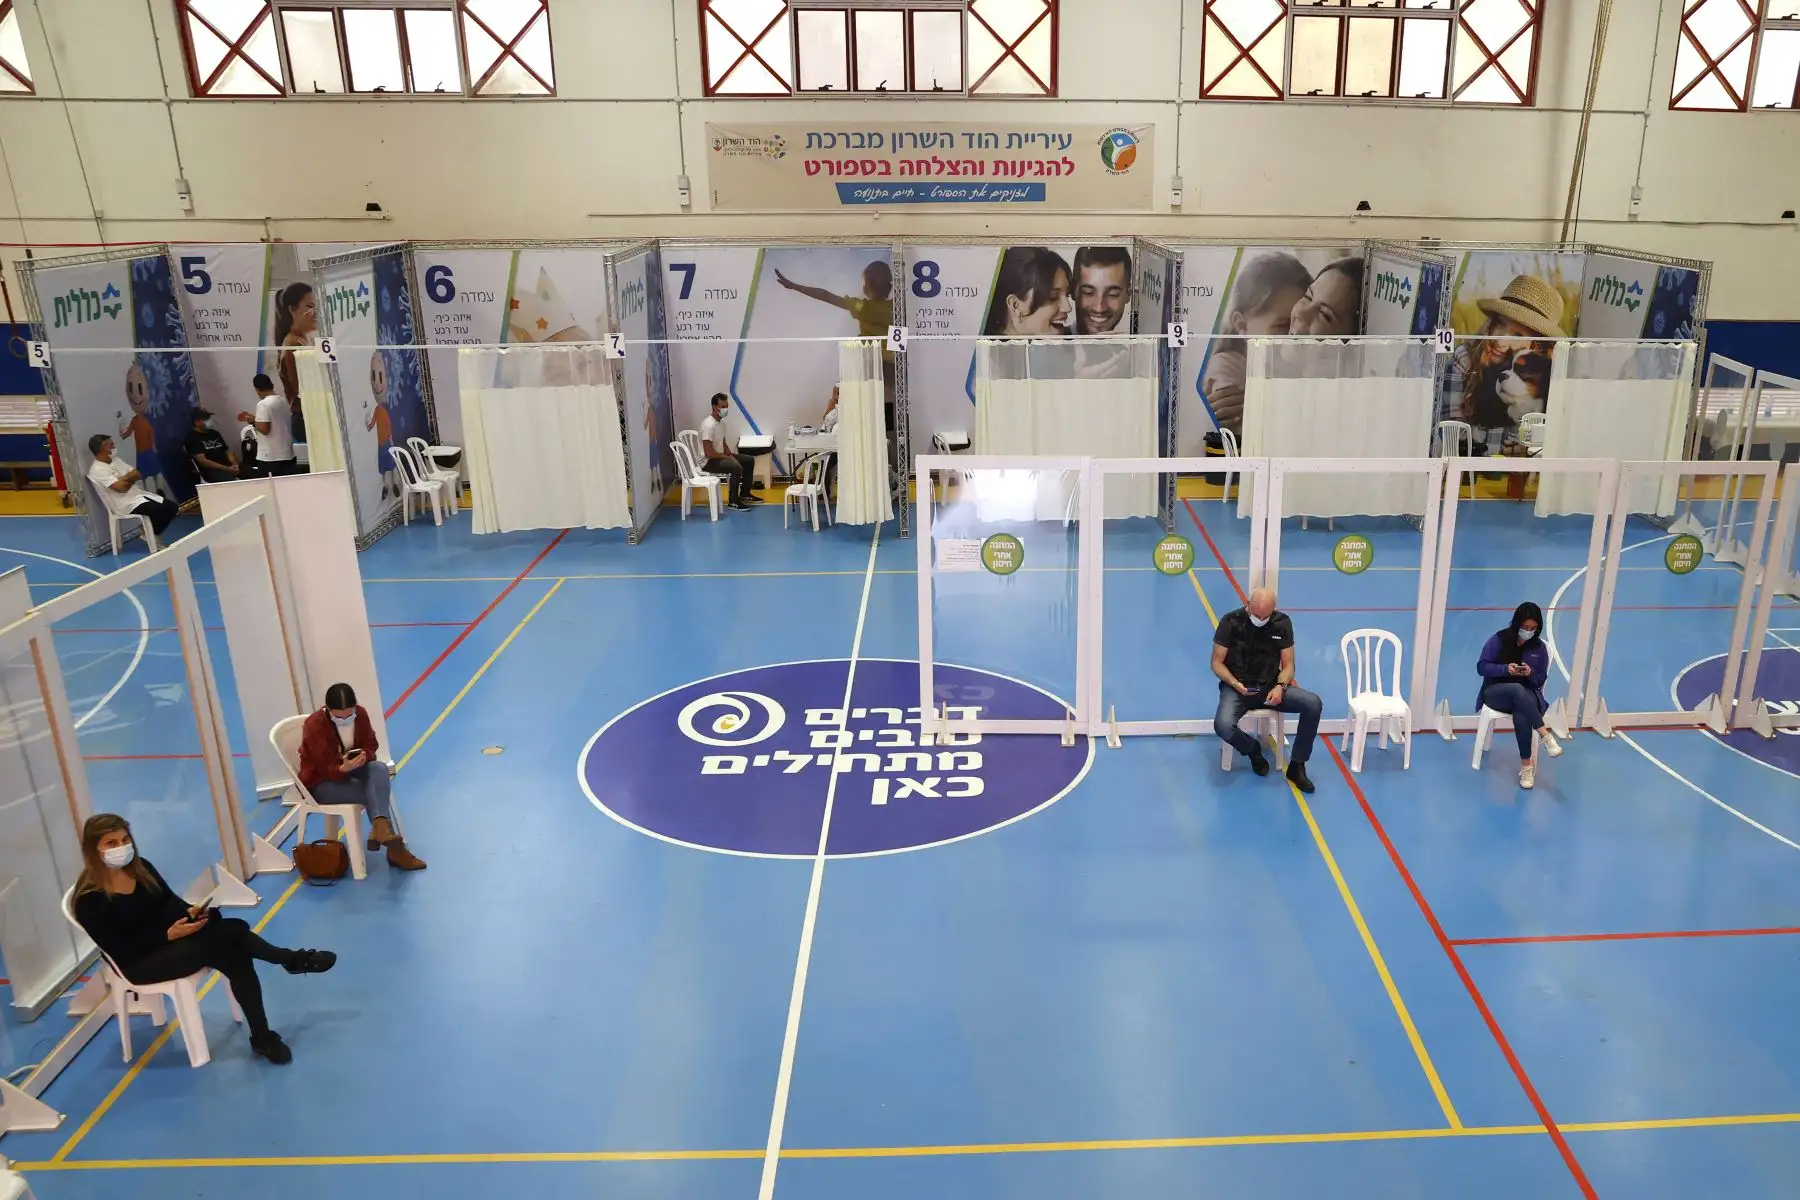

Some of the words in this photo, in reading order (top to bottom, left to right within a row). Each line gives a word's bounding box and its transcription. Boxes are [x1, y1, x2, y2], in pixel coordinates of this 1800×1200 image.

[723, 138, 744, 147] השרון
[747, 138, 760, 146] הוד
[805, 132, 884, 149] מברכת
[891, 132, 954, 153] השרון
[961, 133, 999, 149] הוד
[1005, 132, 1072, 150] עיריית
[804, 159, 892, 176] בספורט
[899, 156, 985, 176] והצלחה
[992, 156, 1075, 178] להגינות
[854, 187, 888, 202] בתנועה
[892, 188, 914, 199] חיים
[930, 185, 966, 198] הספורט
[968, 183, 988, 199] את
[180, 256, 212, 295] 5
[669, 263, 697, 300] 7
[912, 260, 941, 298] 8
[217, 282, 251, 293] עמדה
[425, 265, 455, 304] 6
[1374, 271, 1399, 303] כללית
[1589, 275, 1626, 306] כללית
[460, 291, 495, 303] עמדה
[704, 288, 738, 300] עמדה
[945, 286, 978, 298] עמדה
[54, 288, 101, 328] כללית
[935, 308, 954, 316] איזה
[212, 321, 228, 329] עוד
[453, 326, 468, 334] עוד
[695, 323, 710, 331] עוד
[1173, 325, 1183, 338] 9
[223, 334, 242, 342] תהיו
[892, 329, 901, 342] 8
[1437, 331, 1452, 344] 10
[321, 340, 331, 354] 6
[610, 336, 619, 349] 7
[34, 344, 43, 358] 5
[989, 541, 1016, 549] המתנה
[993, 551, 1012, 559] אחרי
[992, 560, 1012, 569] חיסון
[1163, 561, 1183, 570] חיסון
[1343, 560, 1362, 568] חיסון
[1673, 560, 1691, 569] חיסון
[700, 750, 983, 775] מתחילים
[871, 776, 985, 805] כאן
